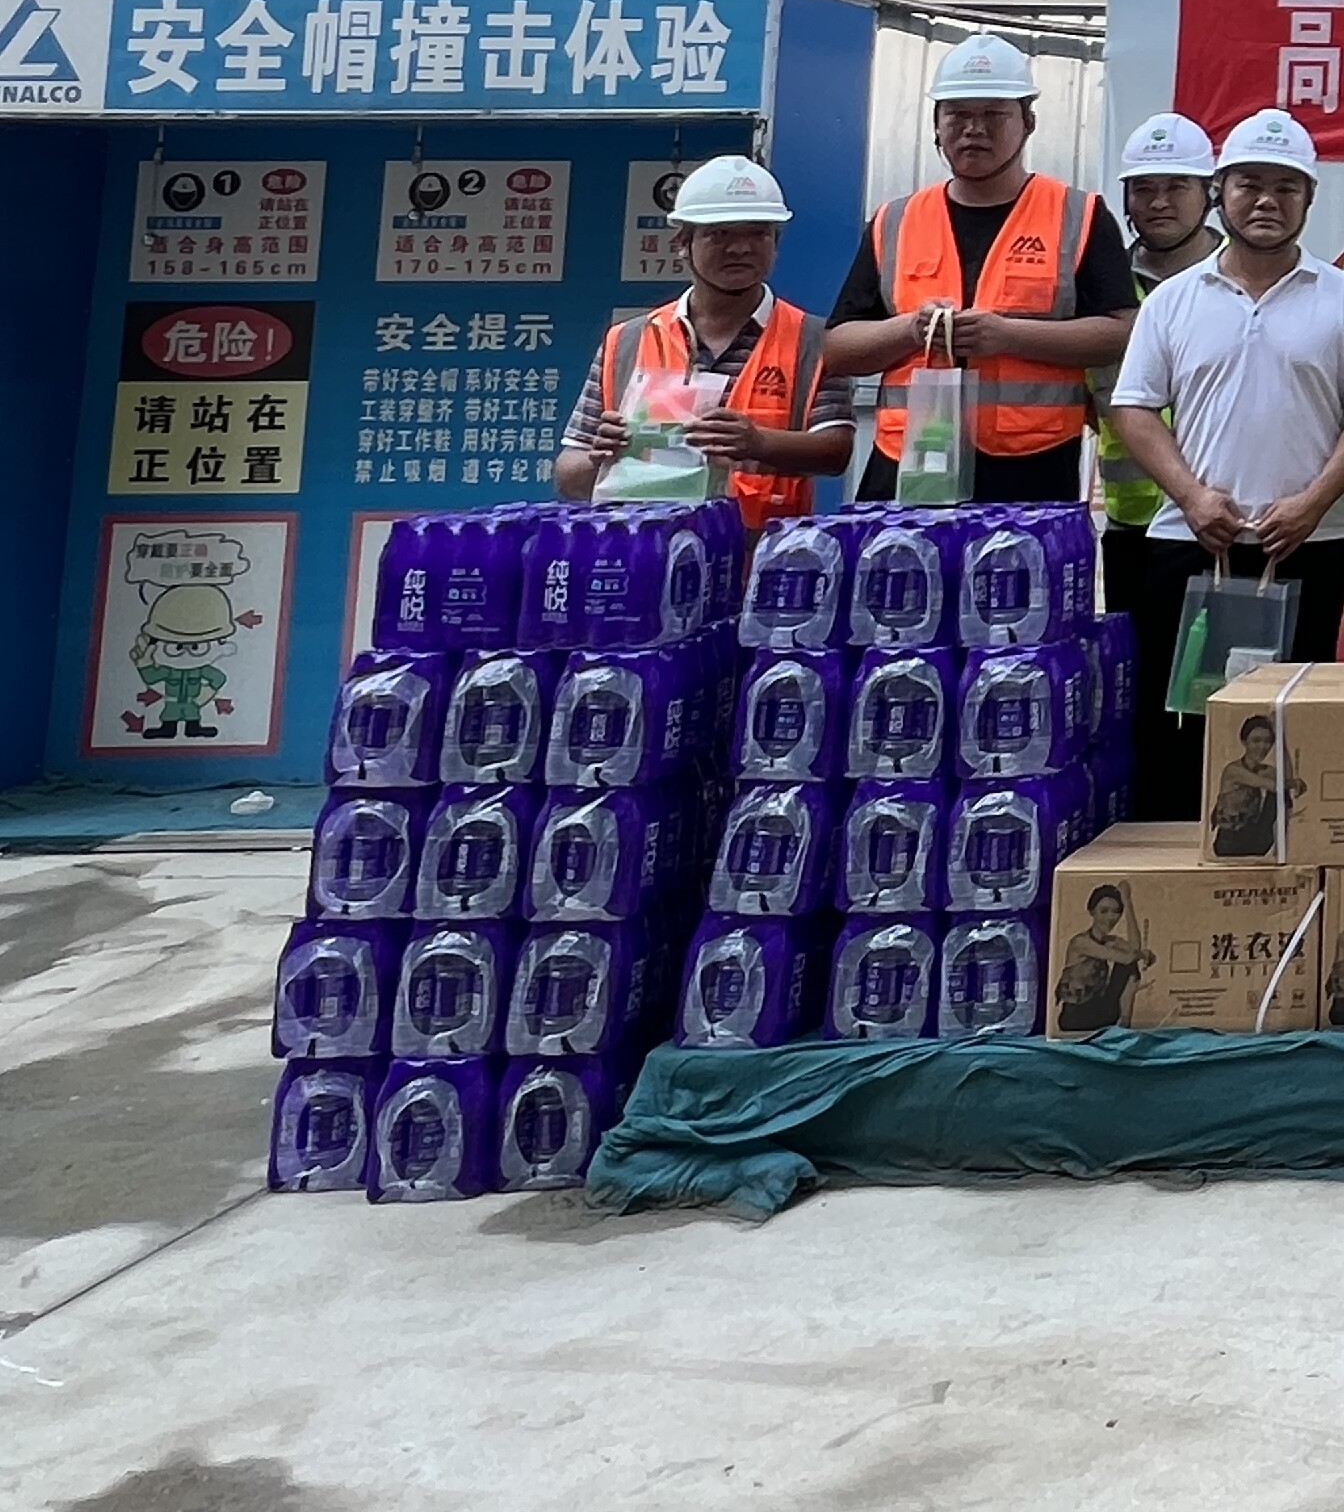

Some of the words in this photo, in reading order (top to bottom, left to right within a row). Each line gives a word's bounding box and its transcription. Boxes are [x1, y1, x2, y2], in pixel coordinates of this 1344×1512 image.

[219, 174, 233, 193] 1
[464, 173, 479, 192] 2
[395, 235, 553, 254] 适合身高范围
[375, 312, 554, 352] 安全提示
[362, 367, 459, 393] 带好安全帽
[465, 367, 560, 393] 系好安全带
[134, 394, 290, 435] 请站在
[128, 446, 283, 486] 正位置
[401, 568, 426, 621] 纯悦
[543, 560, 570, 612] 纯悦
